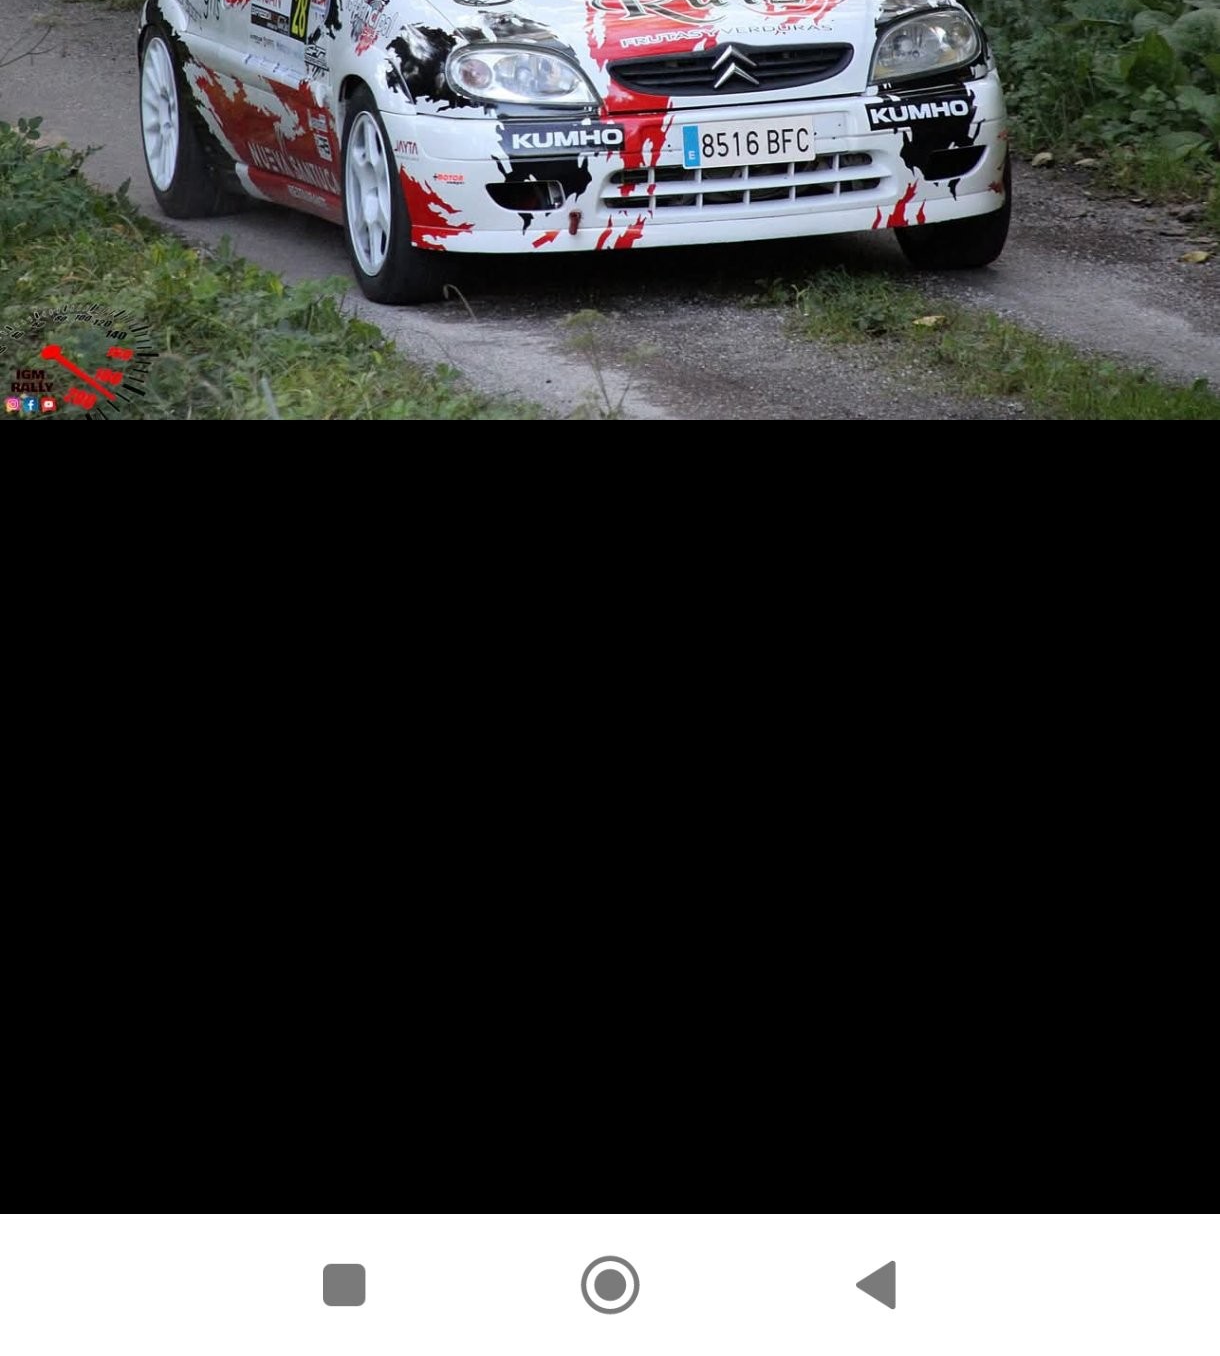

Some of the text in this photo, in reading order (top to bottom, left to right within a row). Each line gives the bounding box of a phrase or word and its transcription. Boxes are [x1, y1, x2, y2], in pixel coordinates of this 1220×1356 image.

[620, 30, 700, 48] FRUTAS
[719, 24, 833, 35] VERDURAS
[871, 99, 970, 124] KUMHO
[512, 128, 624, 150] KUMHO
[702, 128, 809, 158] 8516 BFC
[689, 150, 696, 160] E
